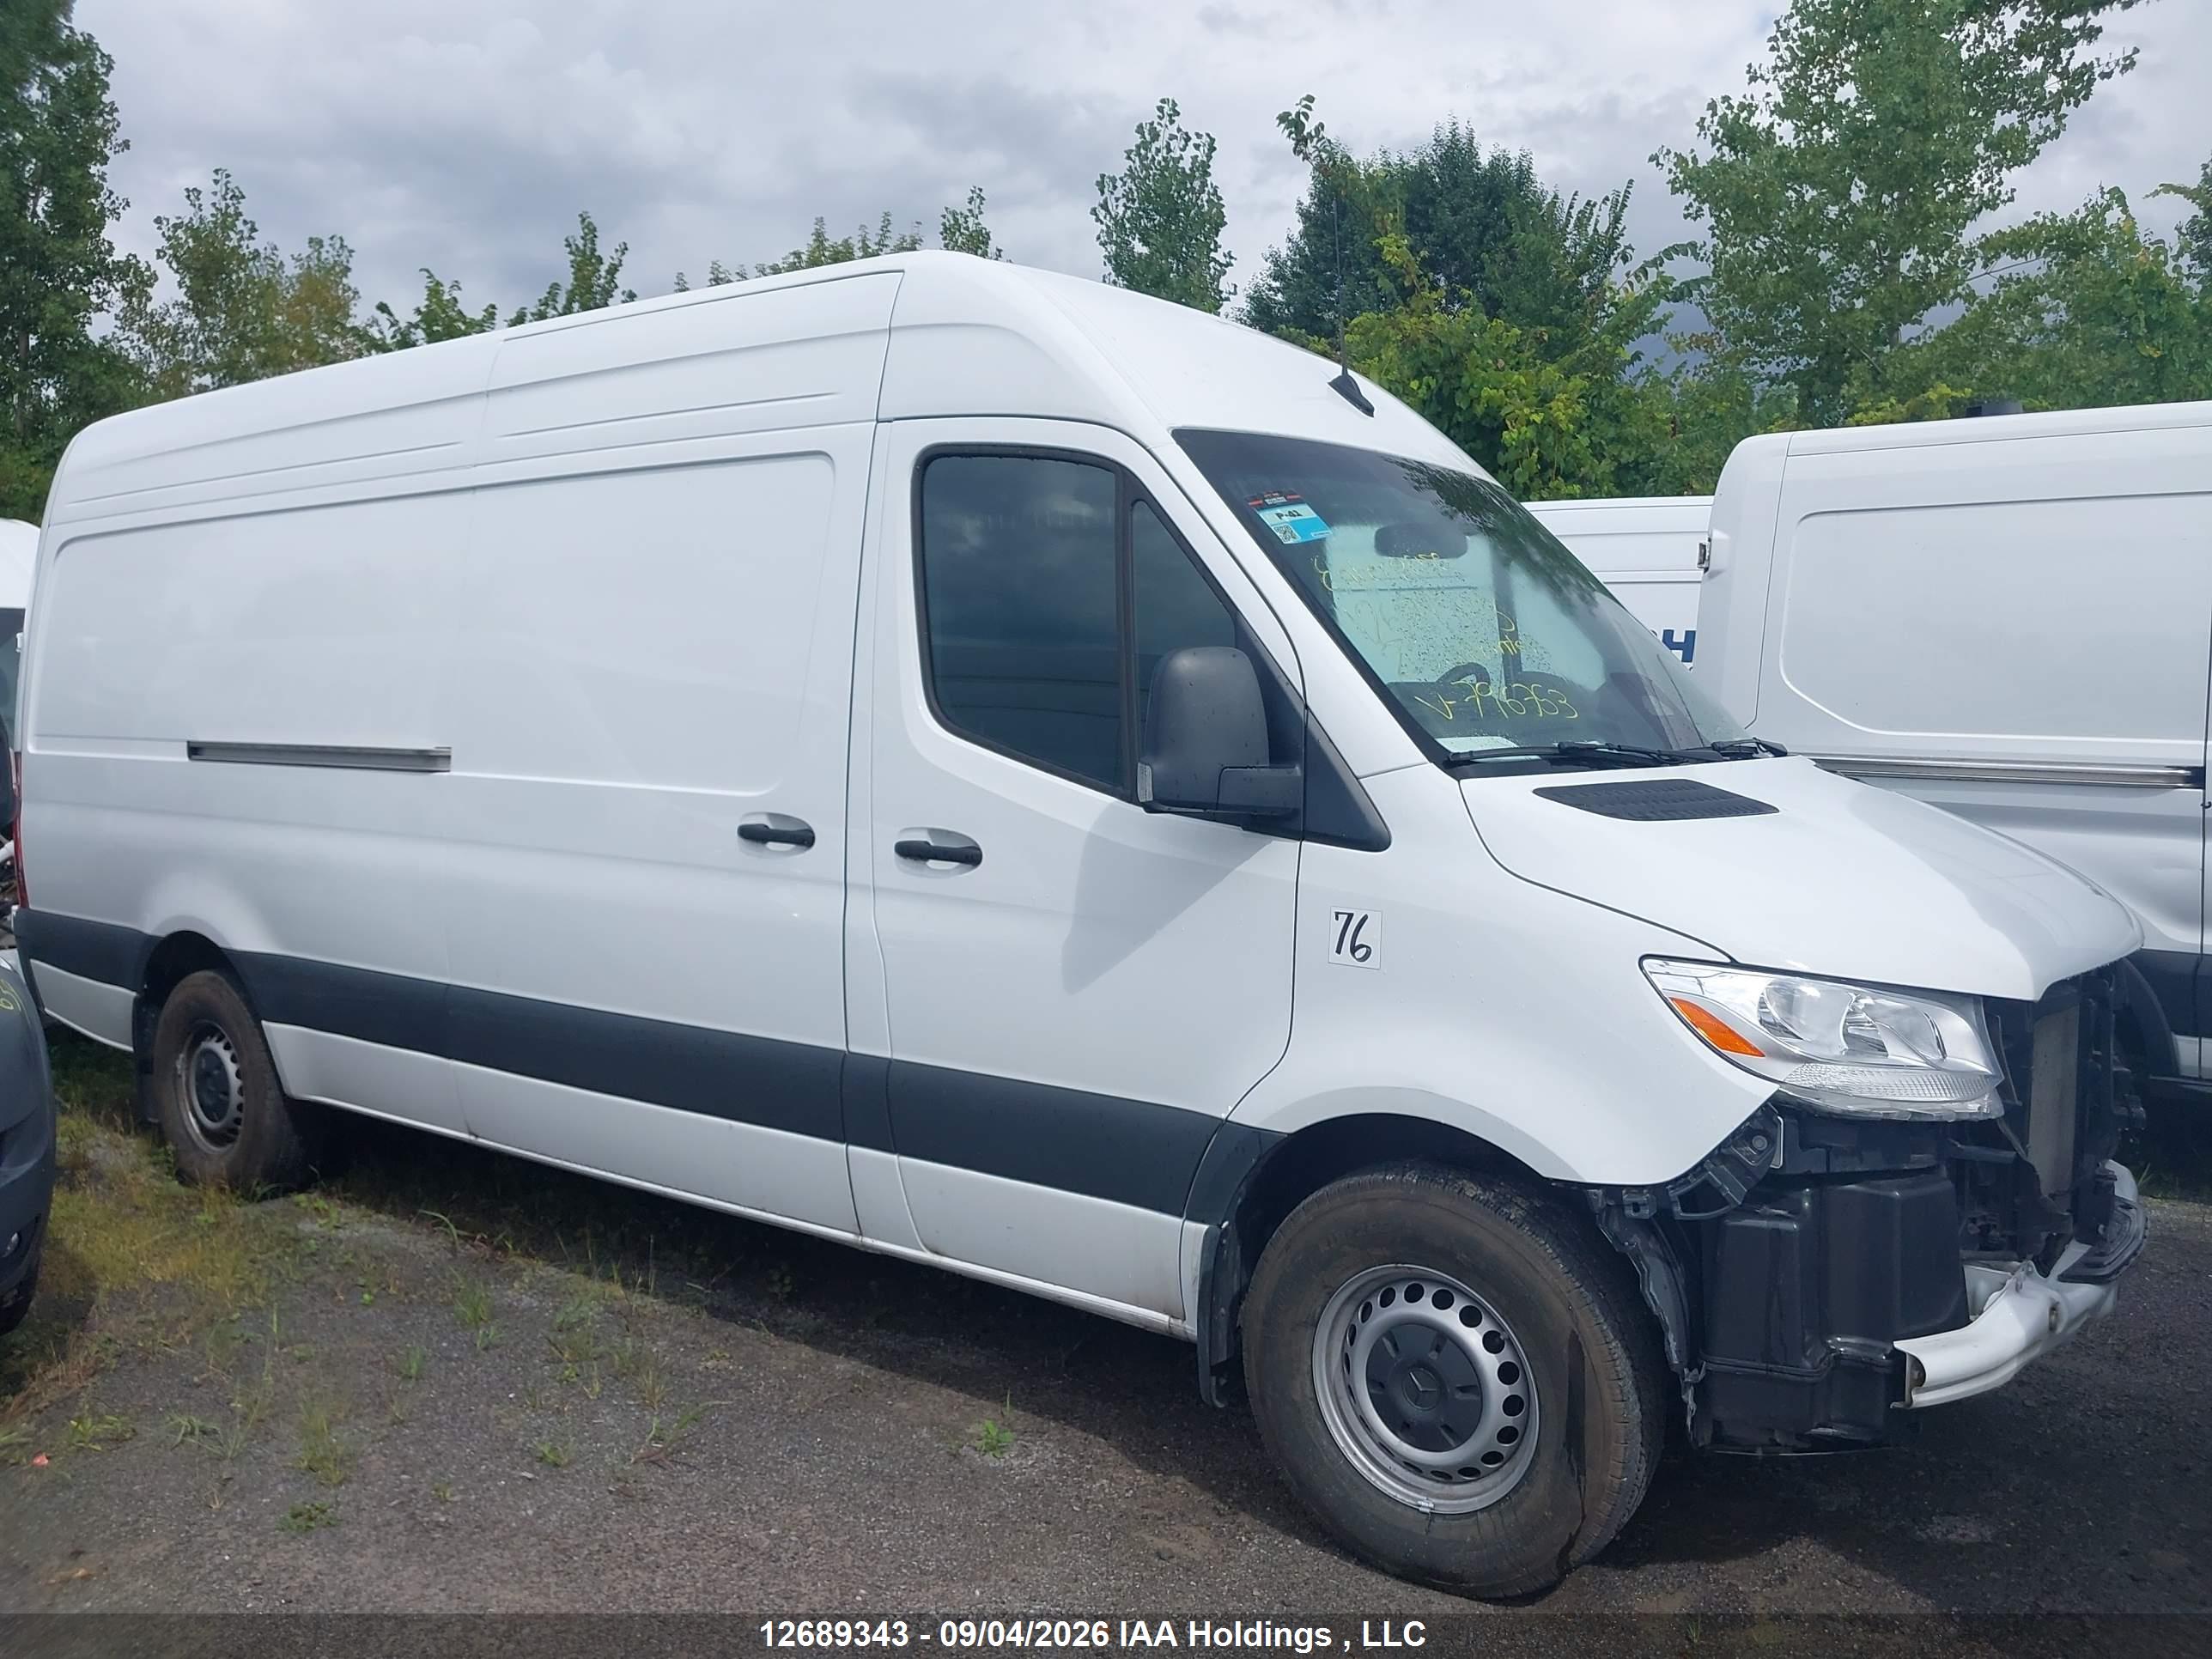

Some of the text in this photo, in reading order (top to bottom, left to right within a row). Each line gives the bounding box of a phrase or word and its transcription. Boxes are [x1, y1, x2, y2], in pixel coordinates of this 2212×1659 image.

[1274, 509, 1304, 520] P-41
[1650, 629, 1697, 663] H
[1334, 910, 1372, 963] 76
